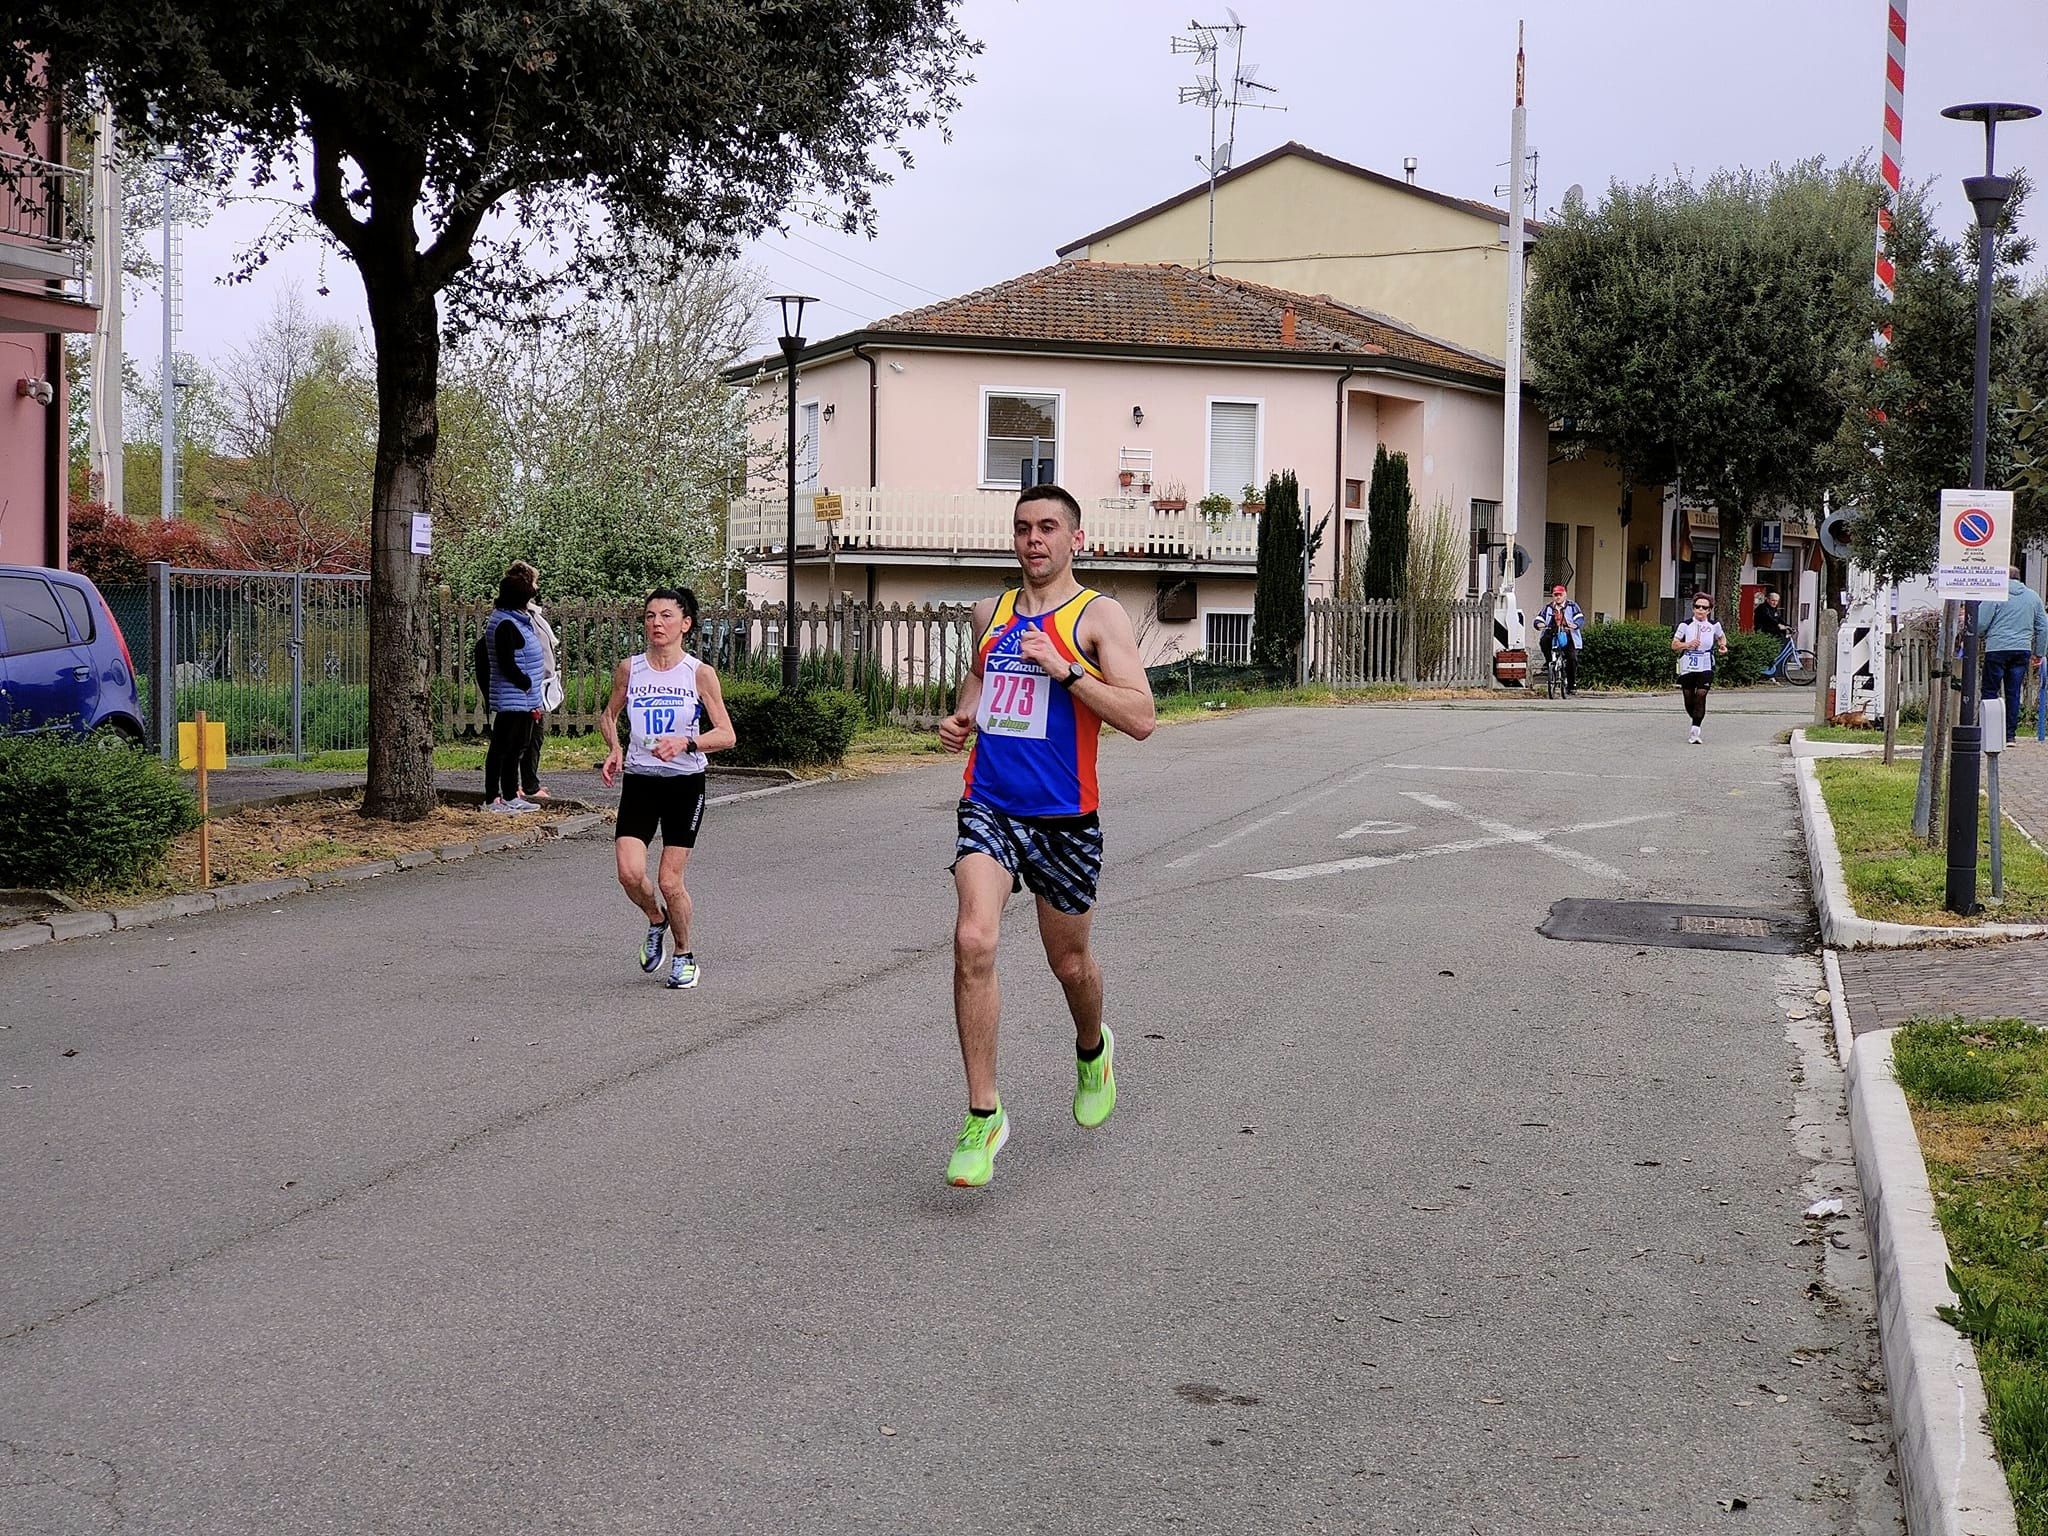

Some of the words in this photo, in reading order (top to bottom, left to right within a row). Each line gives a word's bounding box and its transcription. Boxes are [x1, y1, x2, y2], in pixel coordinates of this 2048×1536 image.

[1689, 656, 1698, 666] 29
[990, 675, 1035, 716] 273
[643, 709, 675, 735] 162
